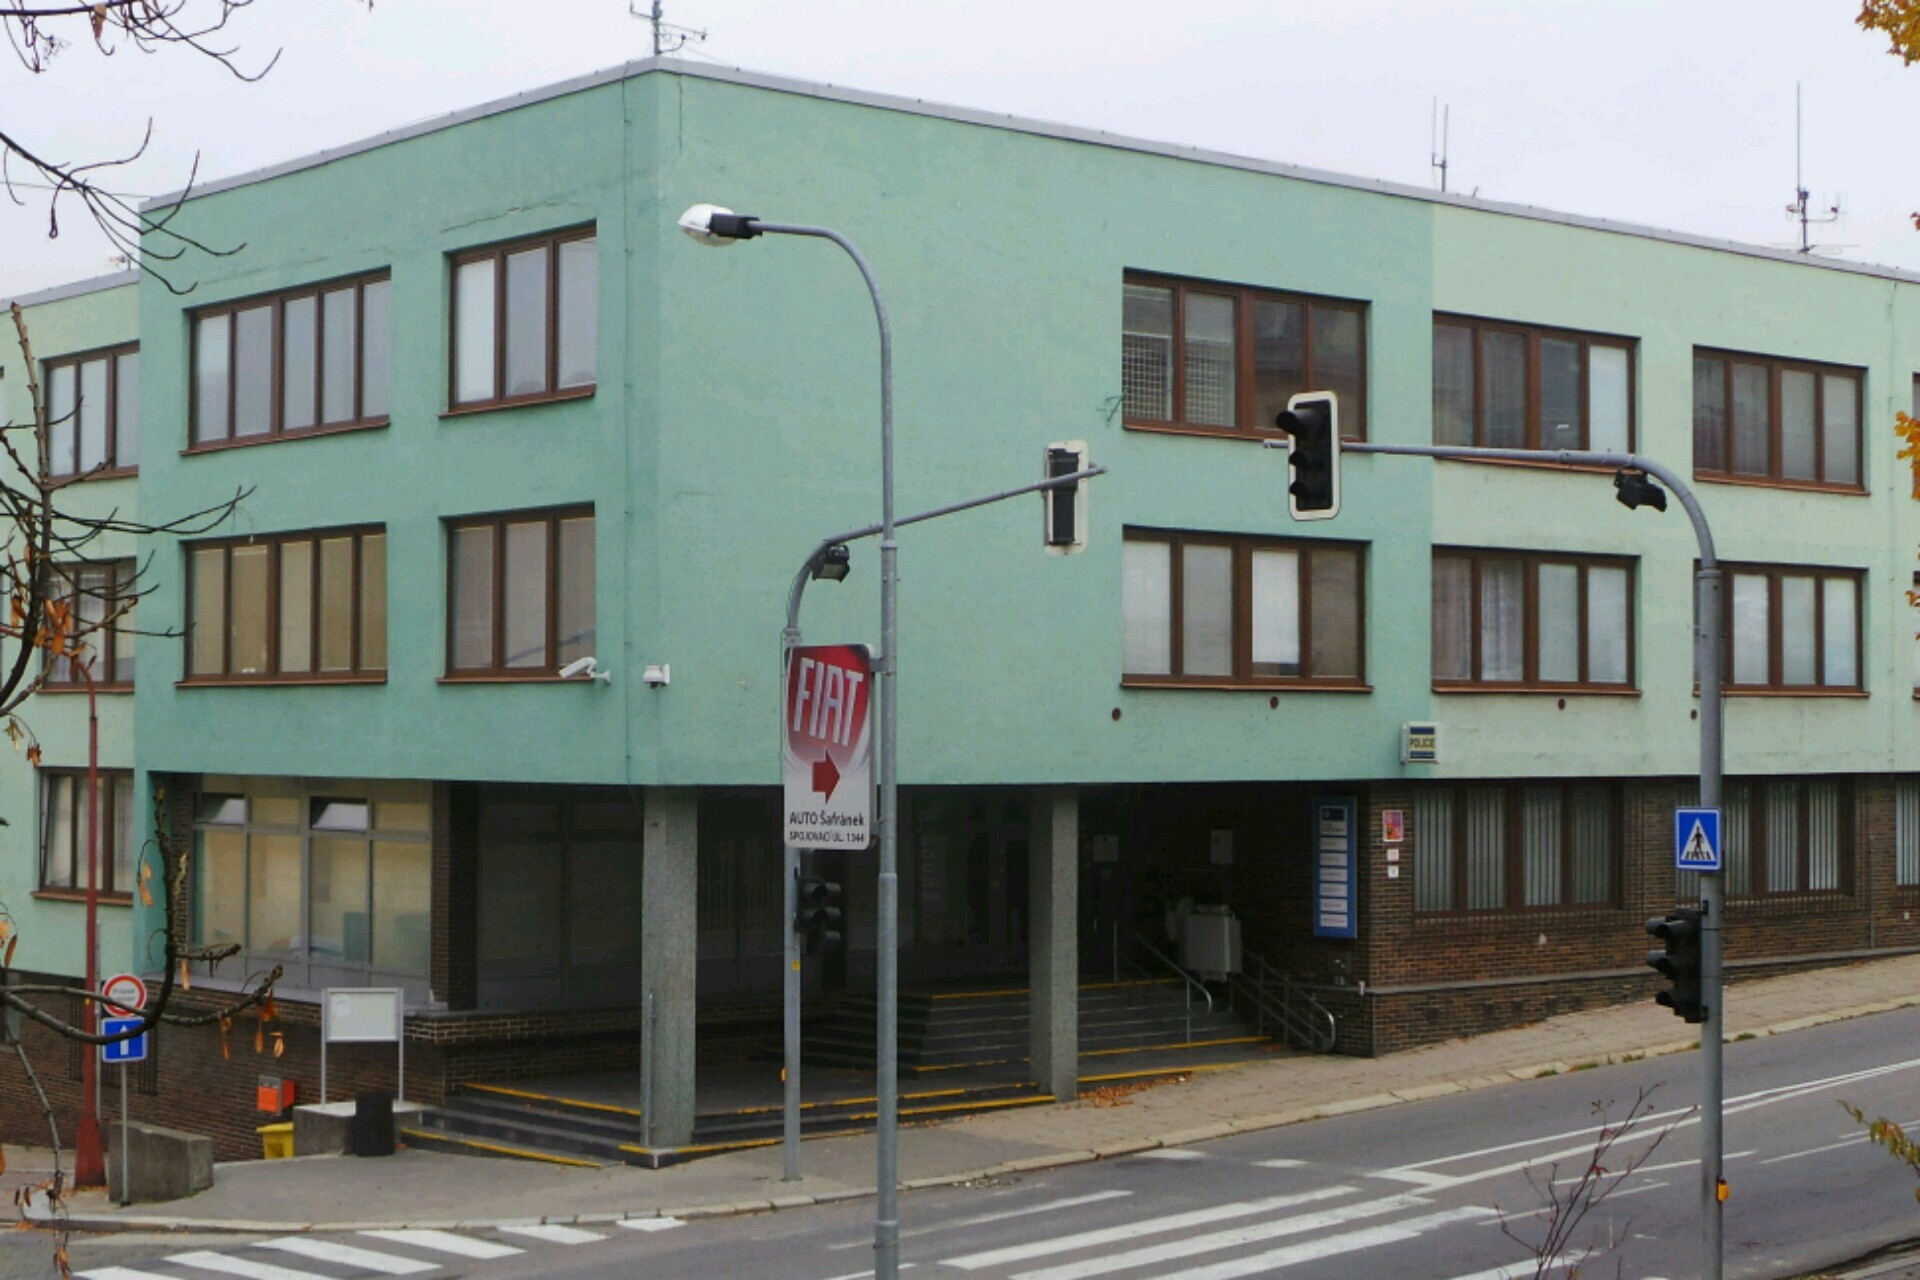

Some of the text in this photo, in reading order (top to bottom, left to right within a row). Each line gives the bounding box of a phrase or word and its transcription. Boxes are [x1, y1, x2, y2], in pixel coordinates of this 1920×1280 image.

[794, 657, 864, 747] FIAT
[789, 809, 865, 826] AUTO Šafránek
